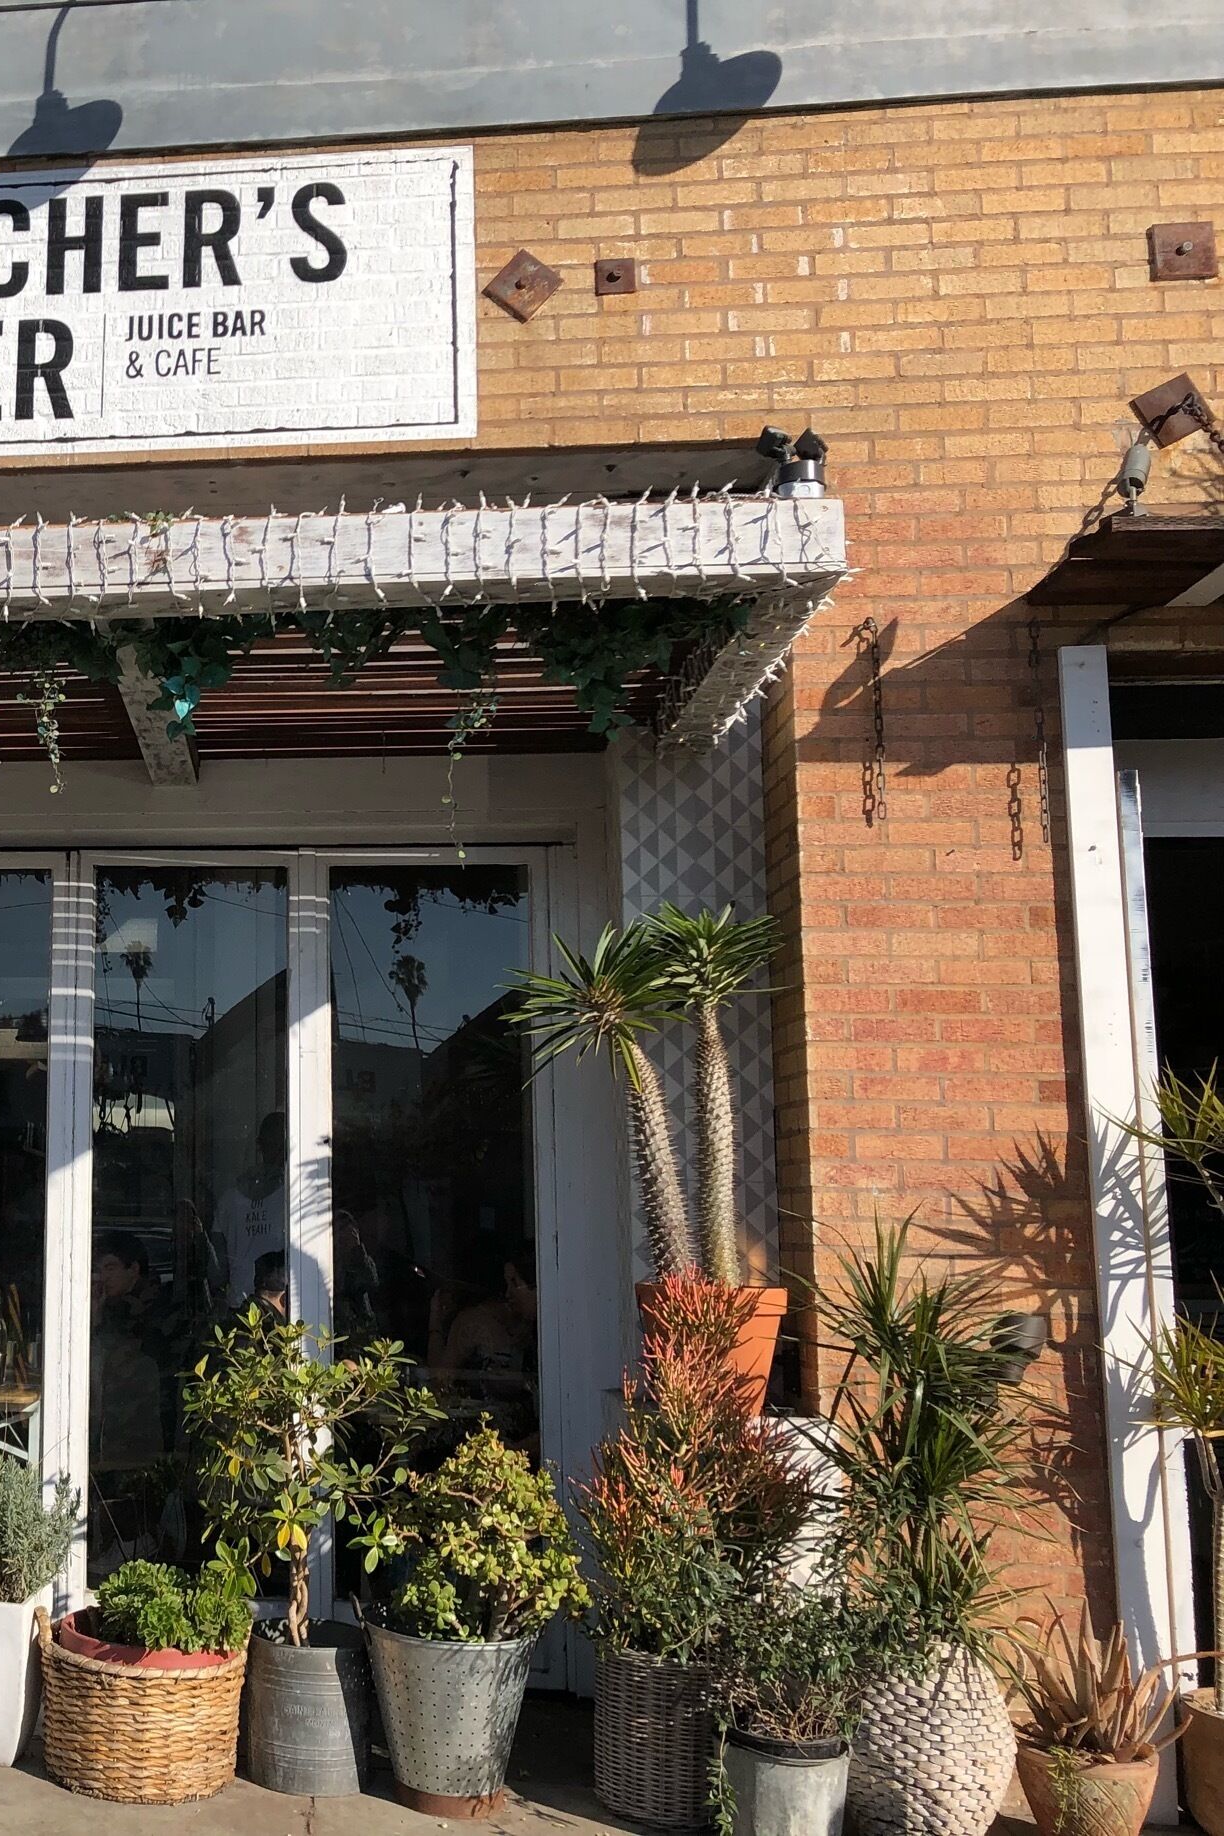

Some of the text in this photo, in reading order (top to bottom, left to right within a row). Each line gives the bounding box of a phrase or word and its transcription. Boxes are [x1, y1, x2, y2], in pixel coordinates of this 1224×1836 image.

[125, 309, 266, 342] JUICE BAR
[126, 347, 222, 379] & CAFE
